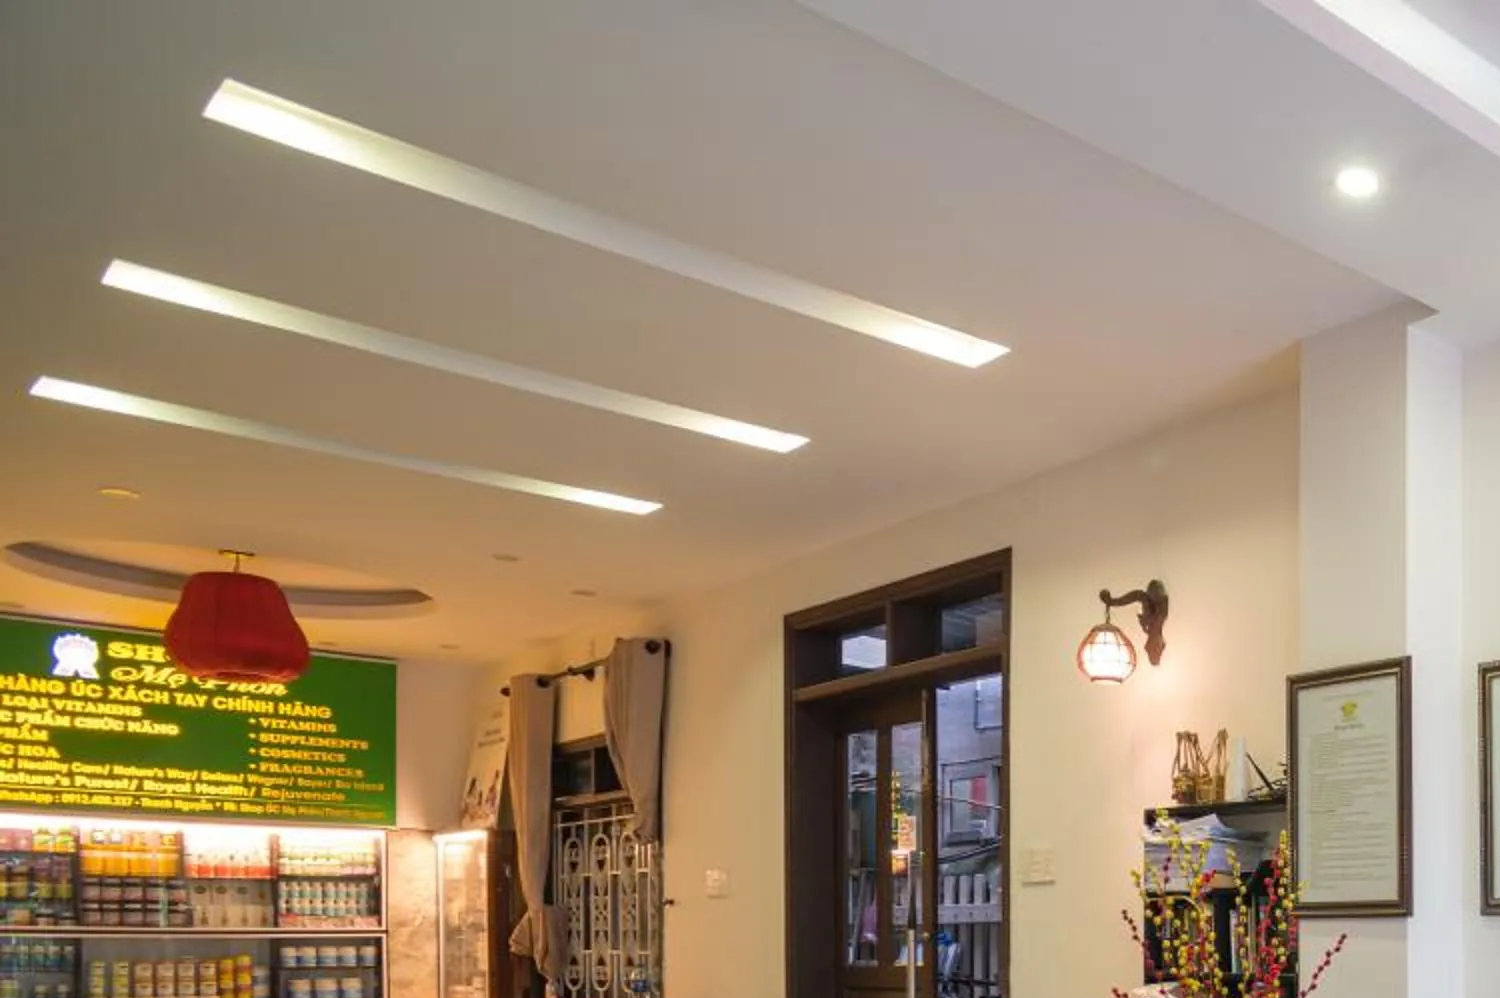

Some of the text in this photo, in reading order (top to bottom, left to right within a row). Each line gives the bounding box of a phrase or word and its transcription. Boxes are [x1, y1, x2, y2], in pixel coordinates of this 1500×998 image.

[71, 679, 103, 698] ÚC
[108, 684, 170, 705] XÁCH
[173, 692, 208, 709] TAY
[213, 694, 274, 715] CHÍNH
[52, 698, 142, 717] VITAMINS
[260, 716, 337, 734] VITAMINS
[259, 733, 369, 750] SUPPLEMENTS
[259, 747, 347, 763] COSMETICS
